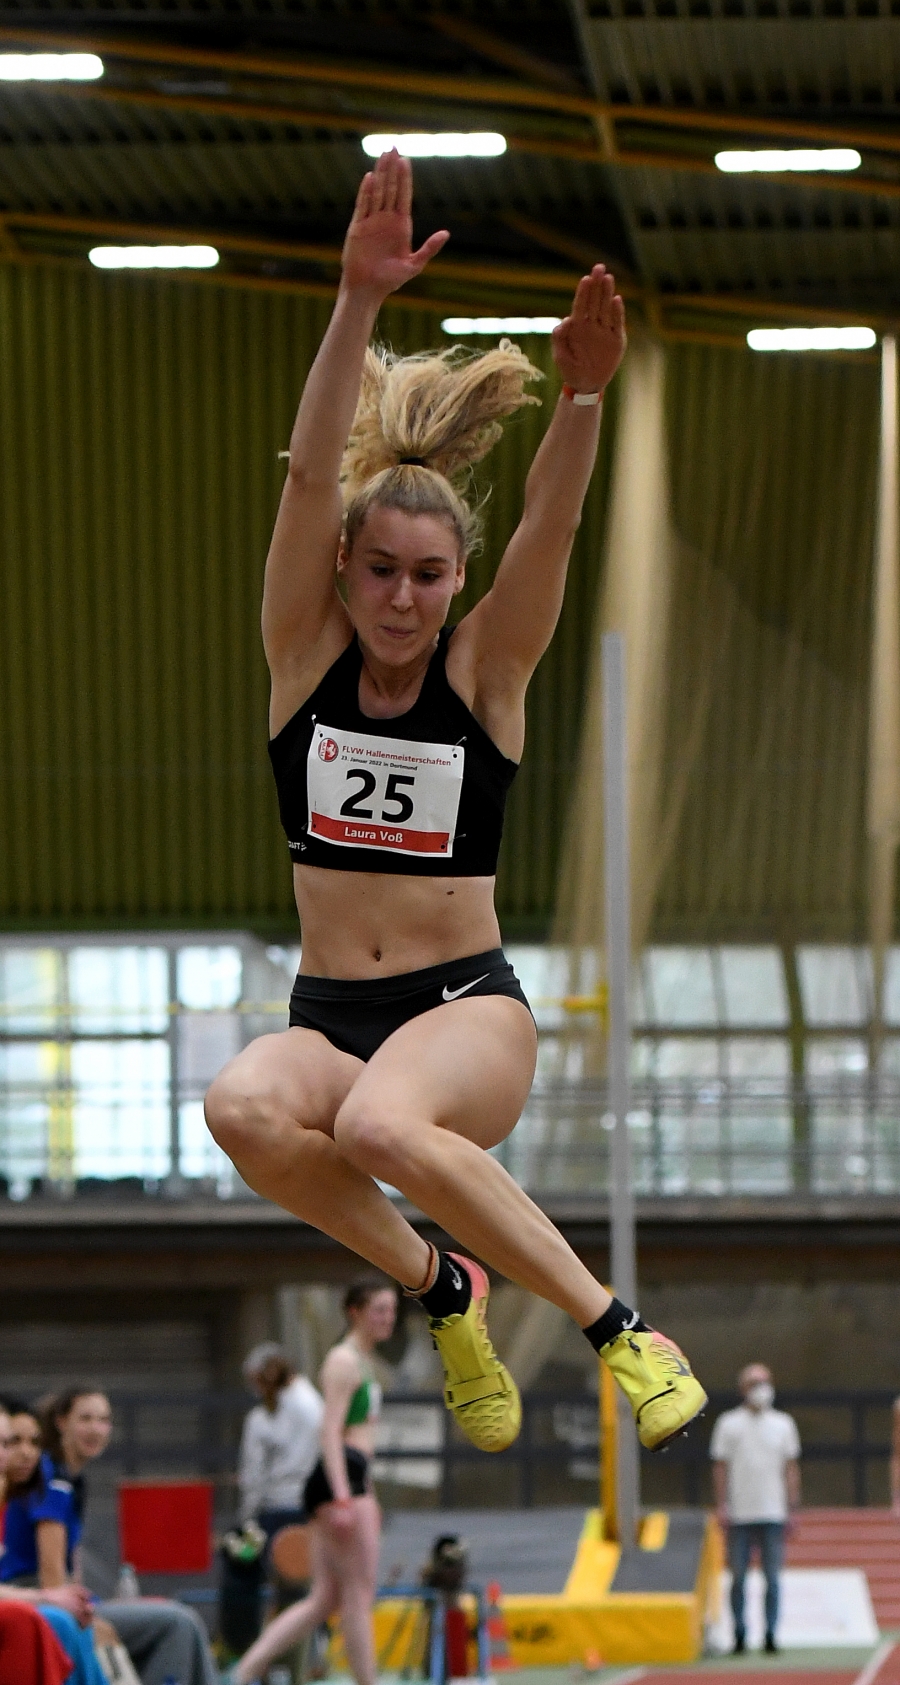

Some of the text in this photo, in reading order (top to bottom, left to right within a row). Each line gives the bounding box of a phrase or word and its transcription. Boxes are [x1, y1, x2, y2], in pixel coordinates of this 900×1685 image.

[342, 745, 451, 766] FLVW Hallenmeisterschaften
[390, 762, 418, 771] Dortmund
[340, 768, 415, 823] 25
[345, 826, 403, 843] Laura Voß
